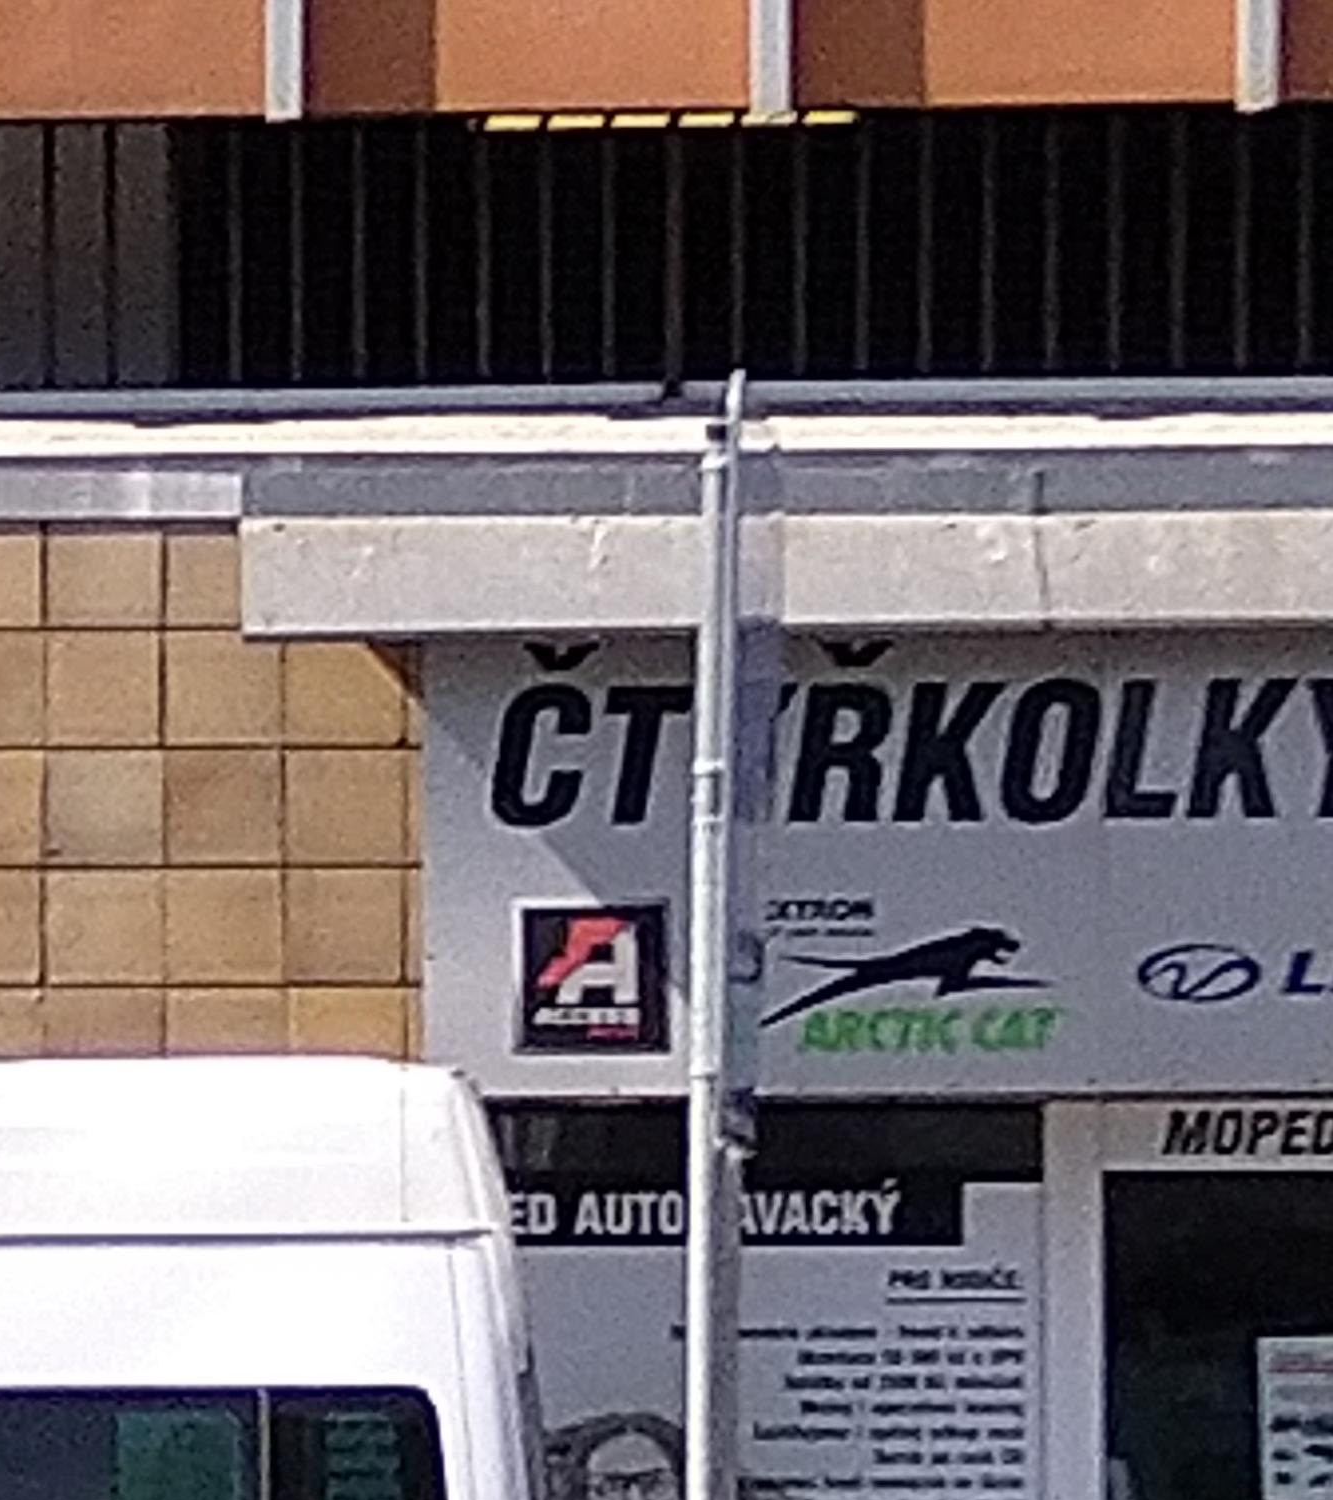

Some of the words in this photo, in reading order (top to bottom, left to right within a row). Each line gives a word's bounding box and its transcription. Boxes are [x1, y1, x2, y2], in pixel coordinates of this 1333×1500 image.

[490, 640, 1333, 827] ČTŘKOLK
[801, 1007, 963, 1054] ARCTIC
[970, 1005, 1067, 1052] CAT
